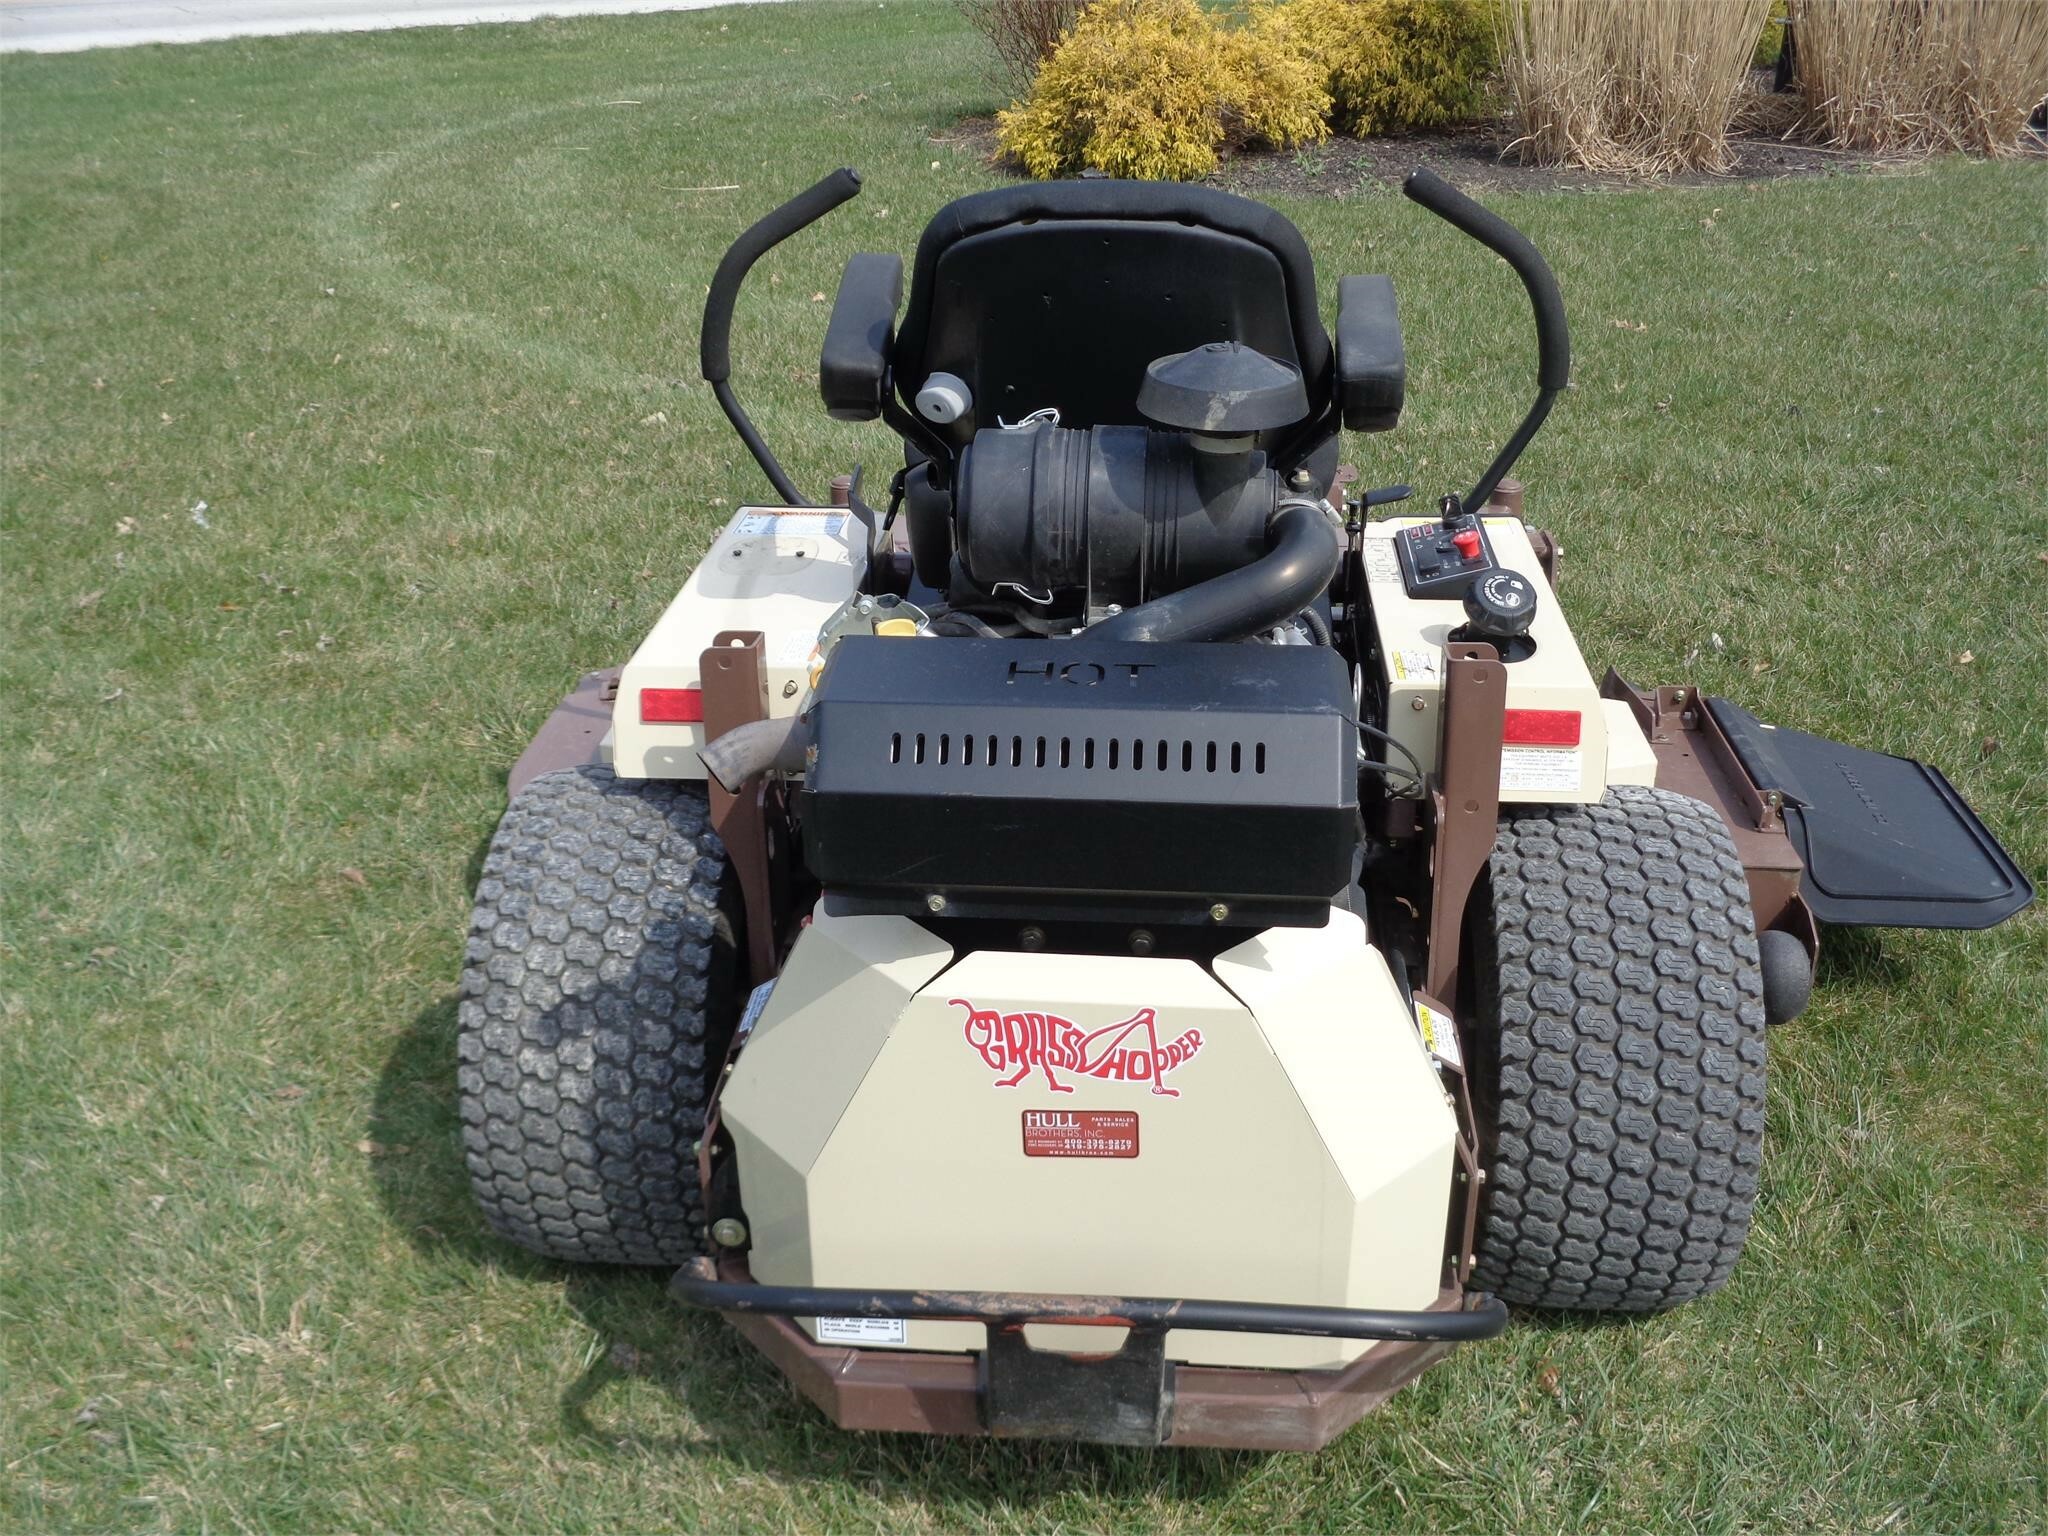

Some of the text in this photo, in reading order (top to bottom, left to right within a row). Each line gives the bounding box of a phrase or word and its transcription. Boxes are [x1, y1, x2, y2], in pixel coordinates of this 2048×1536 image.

[1006, 661, 1156, 687] HOT
[948, 999, 1203, 1097] GRASSHOPPER
[1026, 1112, 1080, 1127] HULL
[1084, 1129, 1106, 1138] INC.
